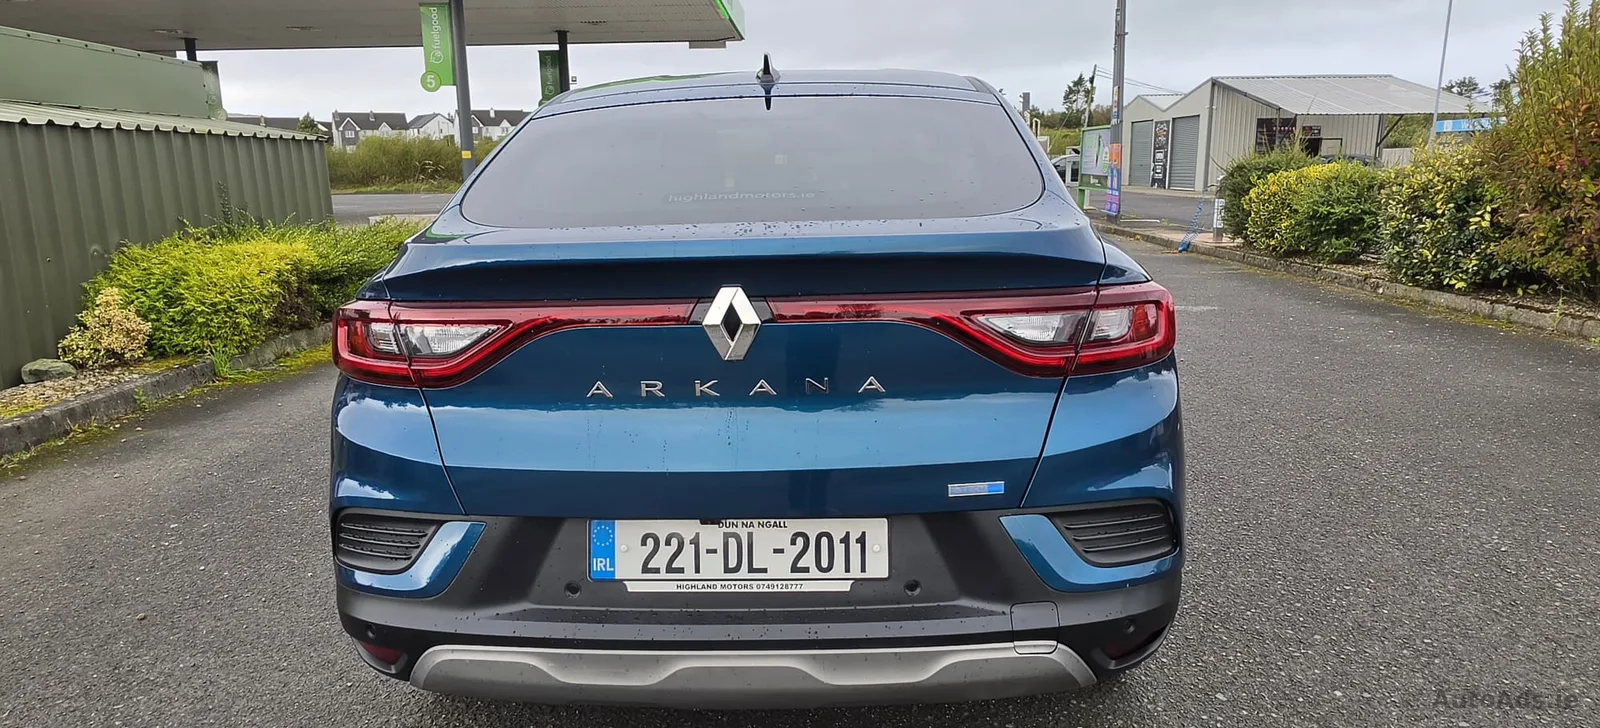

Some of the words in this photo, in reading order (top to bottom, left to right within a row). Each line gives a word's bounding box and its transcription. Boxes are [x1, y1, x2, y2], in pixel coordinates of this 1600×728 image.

[429, 7, 442, 49] fuelgood
[426, 75, 435, 88] 5
[586, 375, 886, 398] ARKANA
[741, 520, 755, 529] NA
[757, 520, 788, 529] NGALL
[592, 557, 614, 572] IRL
[676, 583, 718, 591] HIGHLAND
[720, 583, 754, 591] MOTORS
[756, 582, 804, 590] 0749128777
